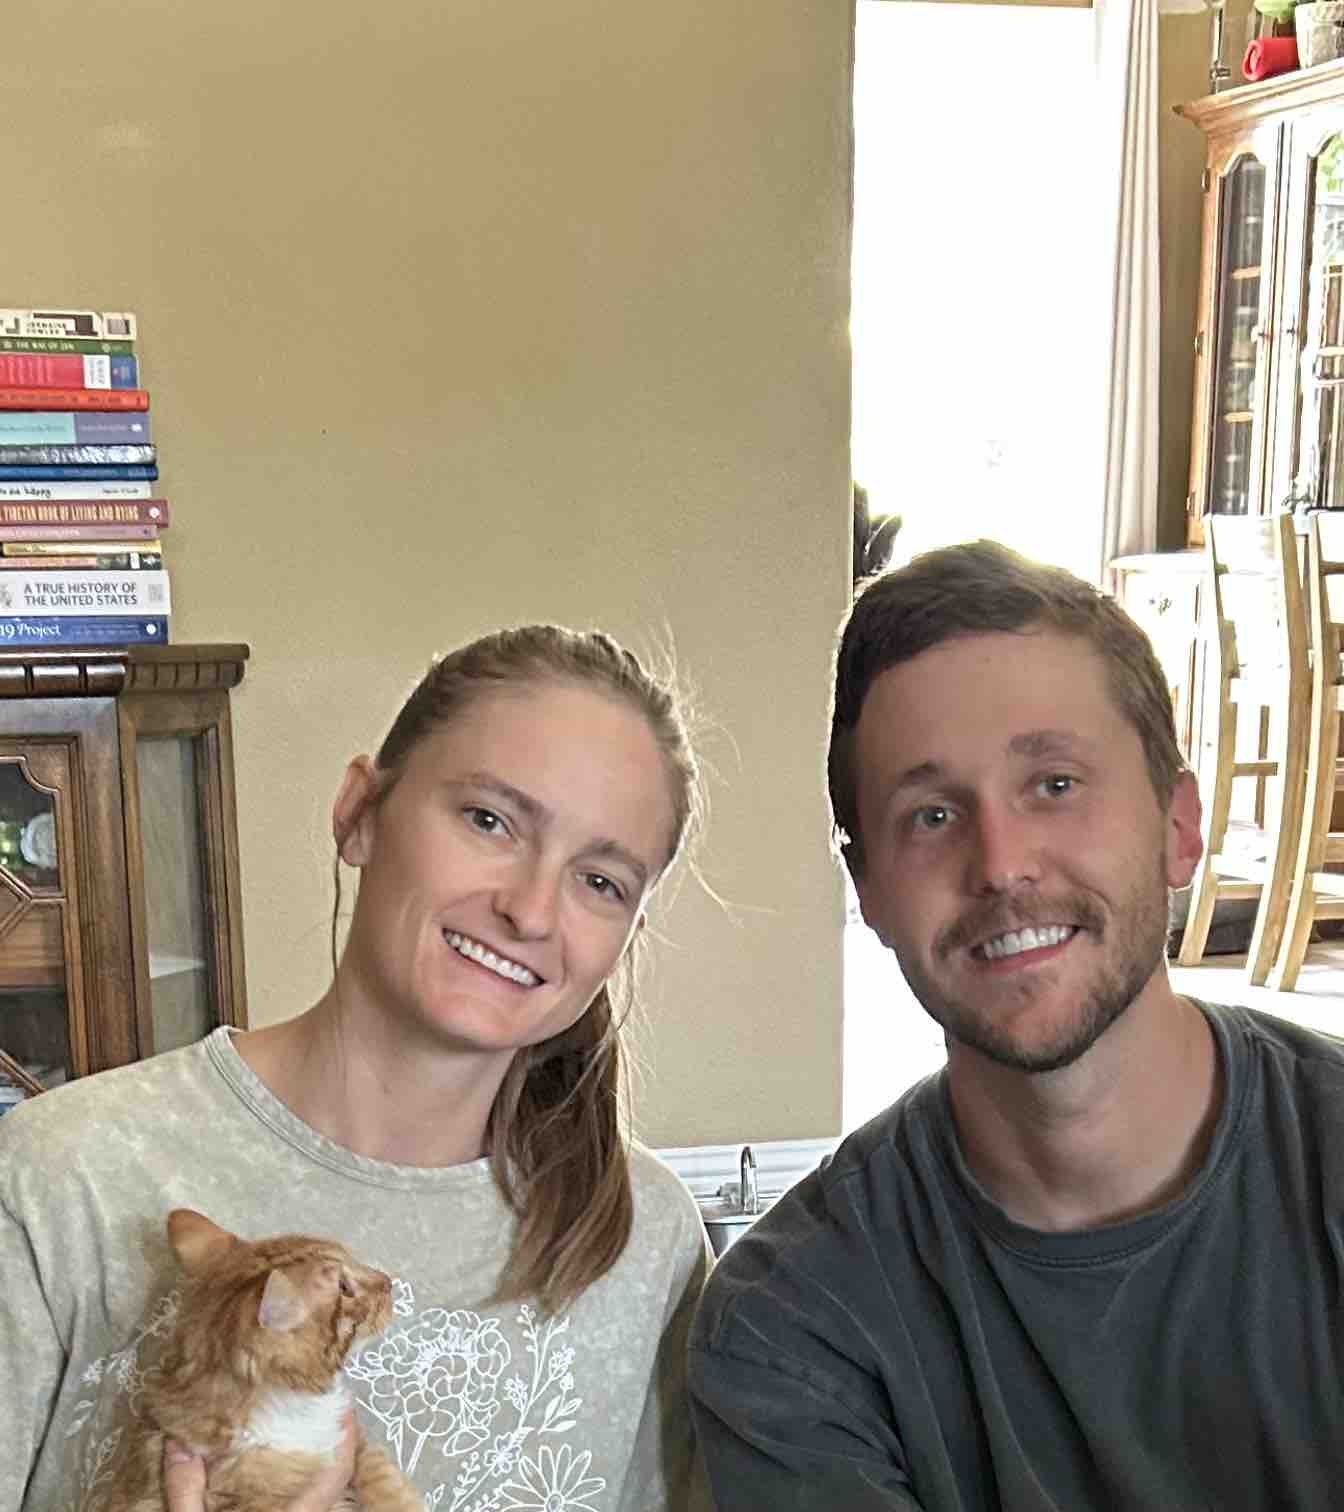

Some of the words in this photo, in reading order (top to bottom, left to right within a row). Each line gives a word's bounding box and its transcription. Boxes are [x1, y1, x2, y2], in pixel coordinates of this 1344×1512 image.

[24, 583, 33, 594] A
[35, 583, 65, 594] TRUE
[68, 583, 119, 594] HISTORY
[122, 583, 137, 594] OF
[24, 595, 46, 606] THE
[51, 595, 94, 606] UNITED
[97, 595, 138, 606] STATES
[16, 623, 61, 639] Project
